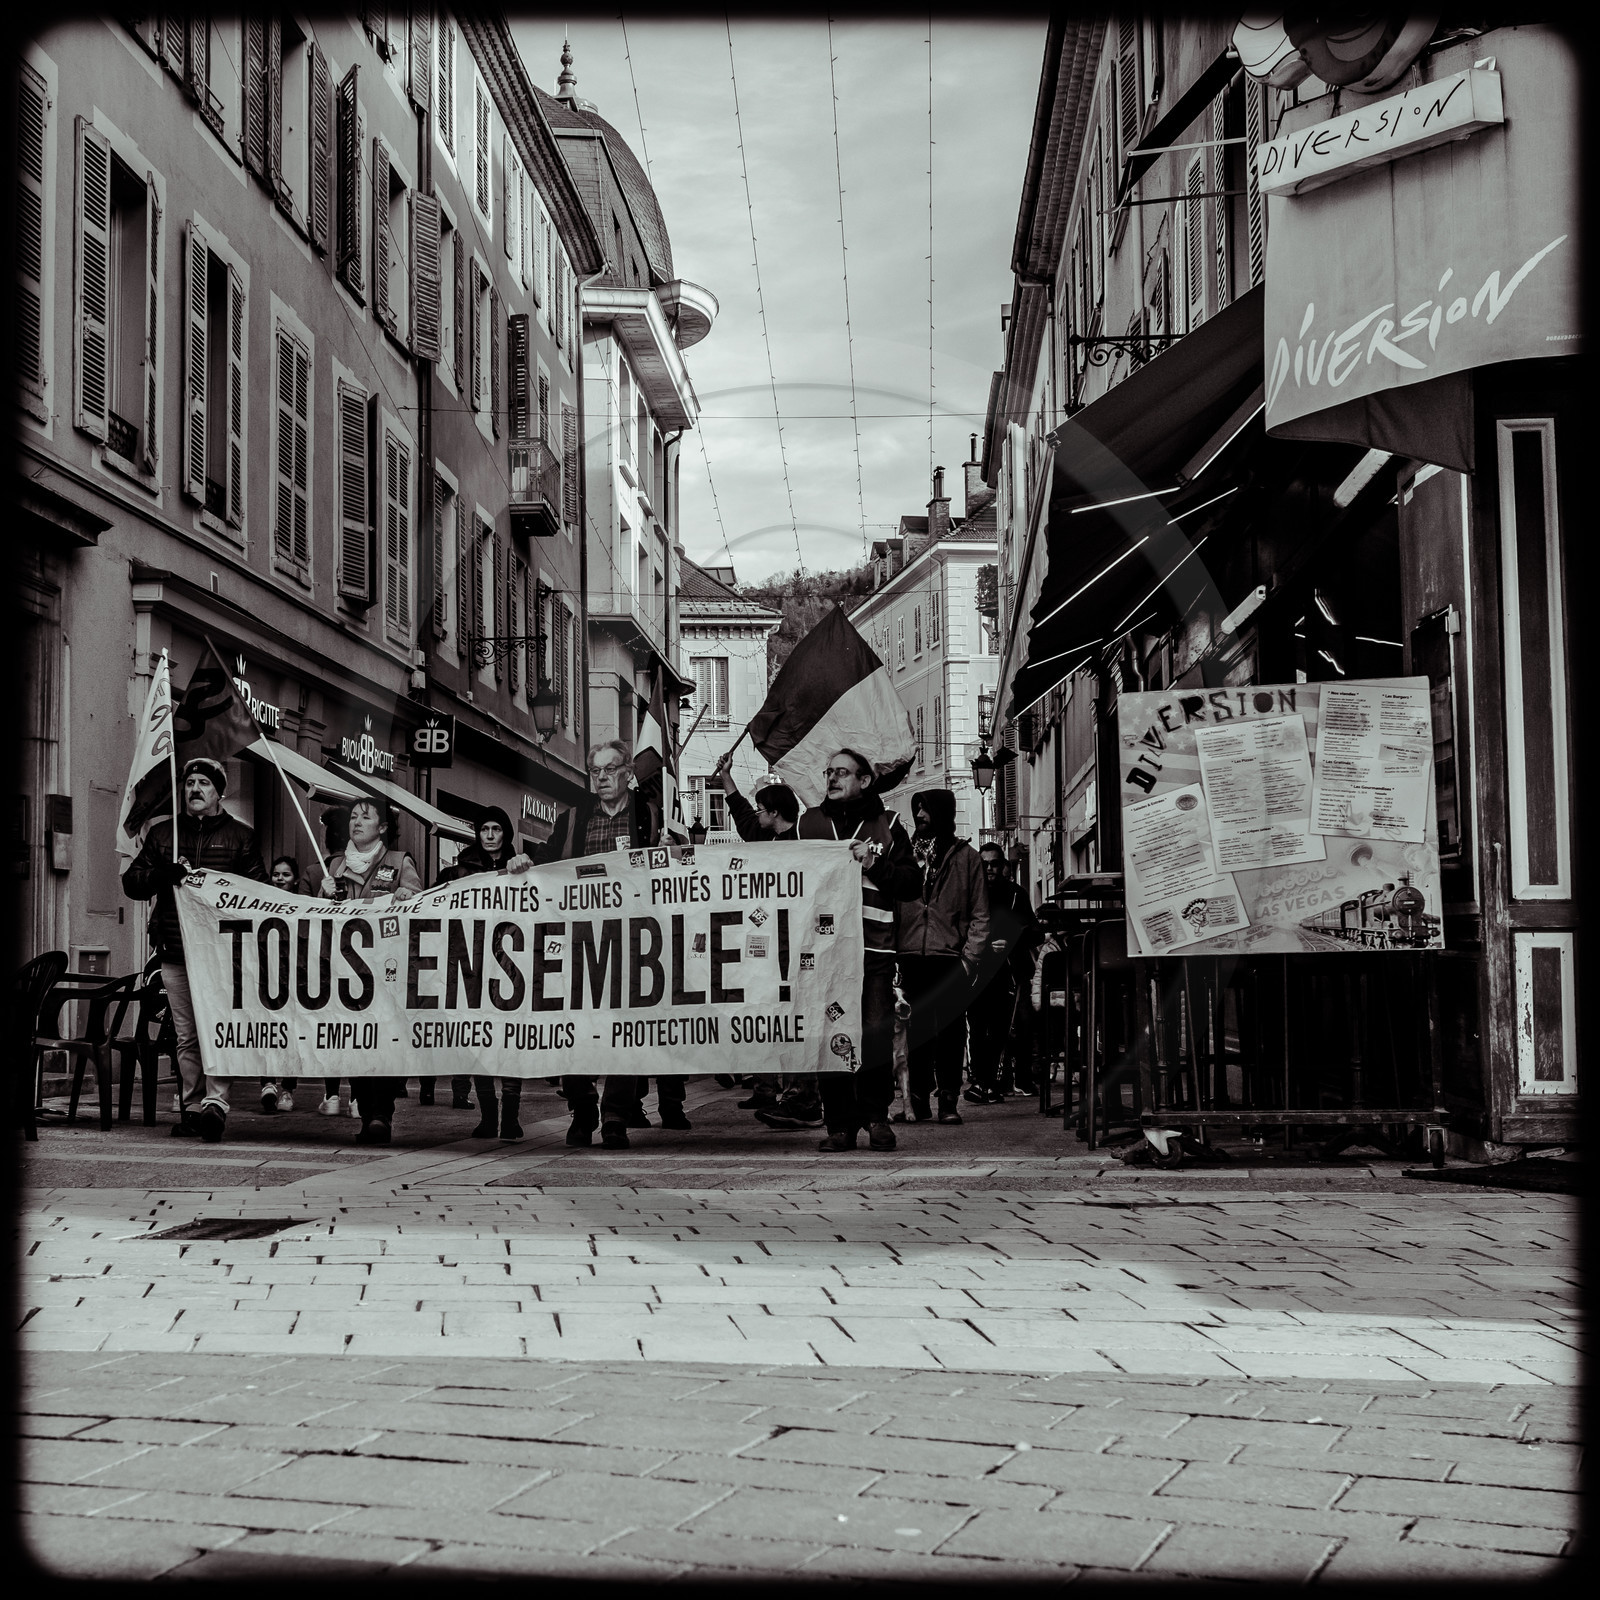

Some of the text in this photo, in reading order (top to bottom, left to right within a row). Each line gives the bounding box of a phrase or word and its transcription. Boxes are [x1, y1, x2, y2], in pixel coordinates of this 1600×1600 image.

[341, 736, 360, 763] BIJOU
[1125, 688, 1297, 795] DIVERSION
[630, 854, 645, 866] cgt
[651, 850, 666, 864] FO
[681, 854, 696, 866] cgt
[215, 870, 804, 916] SALARIÉS PUBLIC RIVÉ RETRAITÉS JEUNES PRIVÉS D'EMPLOI
[1255, 903, 1280, 920] LAS
[1285, 886, 1346, 912] VEGAS
[383, 919, 397, 933] FO
[218, 909, 791, 1012] TOUS ENSEMBLE !
[800, 956, 815, 967] cgt
[214, 1014, 805, 1050] SALAIRES EMPLOI SERVICES PUBLICS PROTECTION SOCIALE
